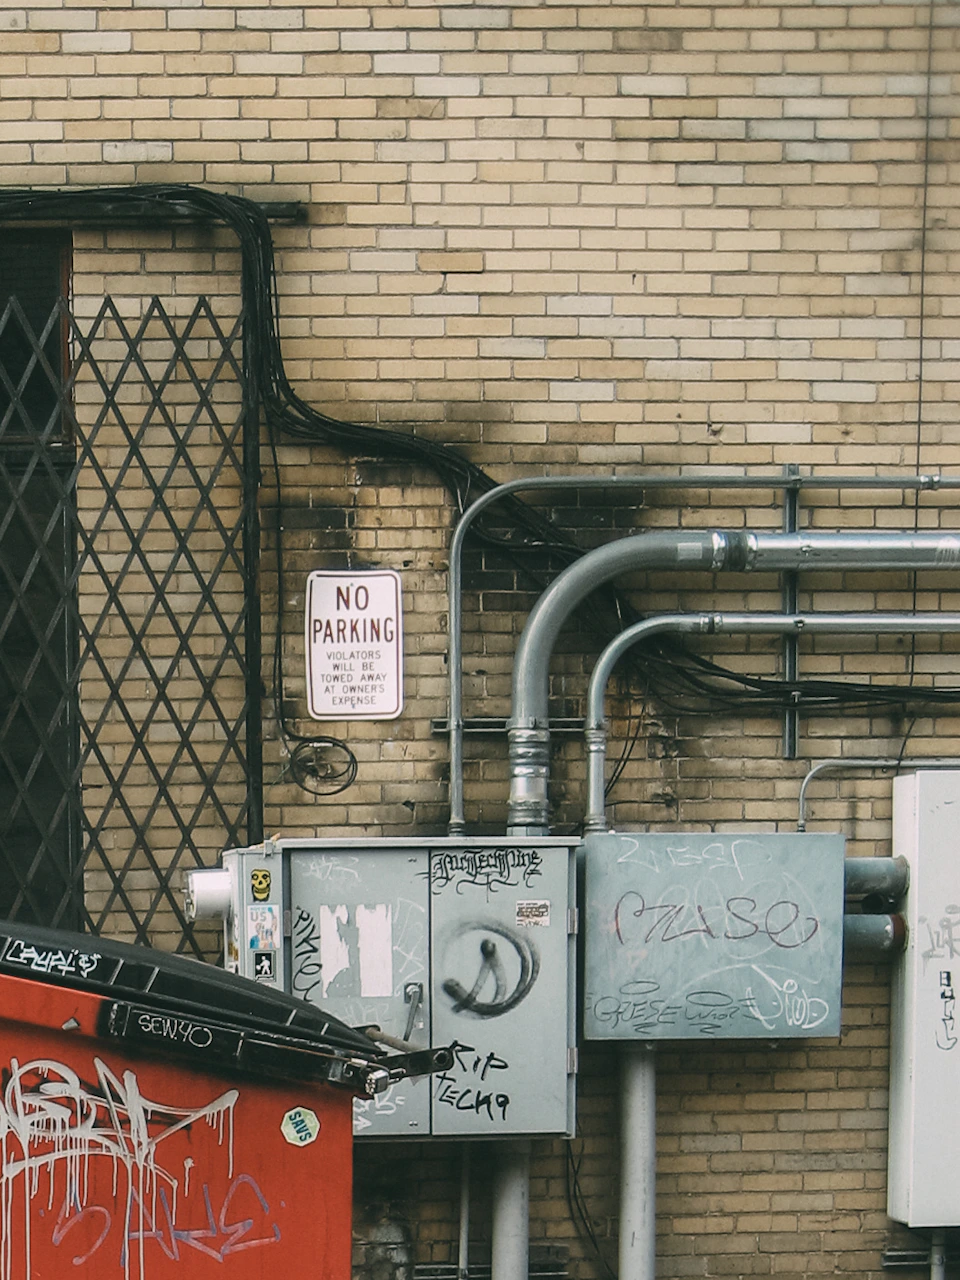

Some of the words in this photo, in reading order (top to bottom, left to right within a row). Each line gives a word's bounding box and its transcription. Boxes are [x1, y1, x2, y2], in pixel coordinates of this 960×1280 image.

[336, 585, 369, 611] NO
[313, 617, 394, 644] PARKING
[326, 650, 381, 660] VIOLATORS
[332, 662, 355, 671] WILL
[362, 661, 375, 671] BE
[321, 673, 353, 683] TOWED
[360, 673, 387, 683] AWAY
[324, 685, 335, 694] AT
[342, 684, 385, 694] OWNER'S
[332, 696, 376, 705] EXPENSE
[288, 1110, 312, 1142] SAVS
